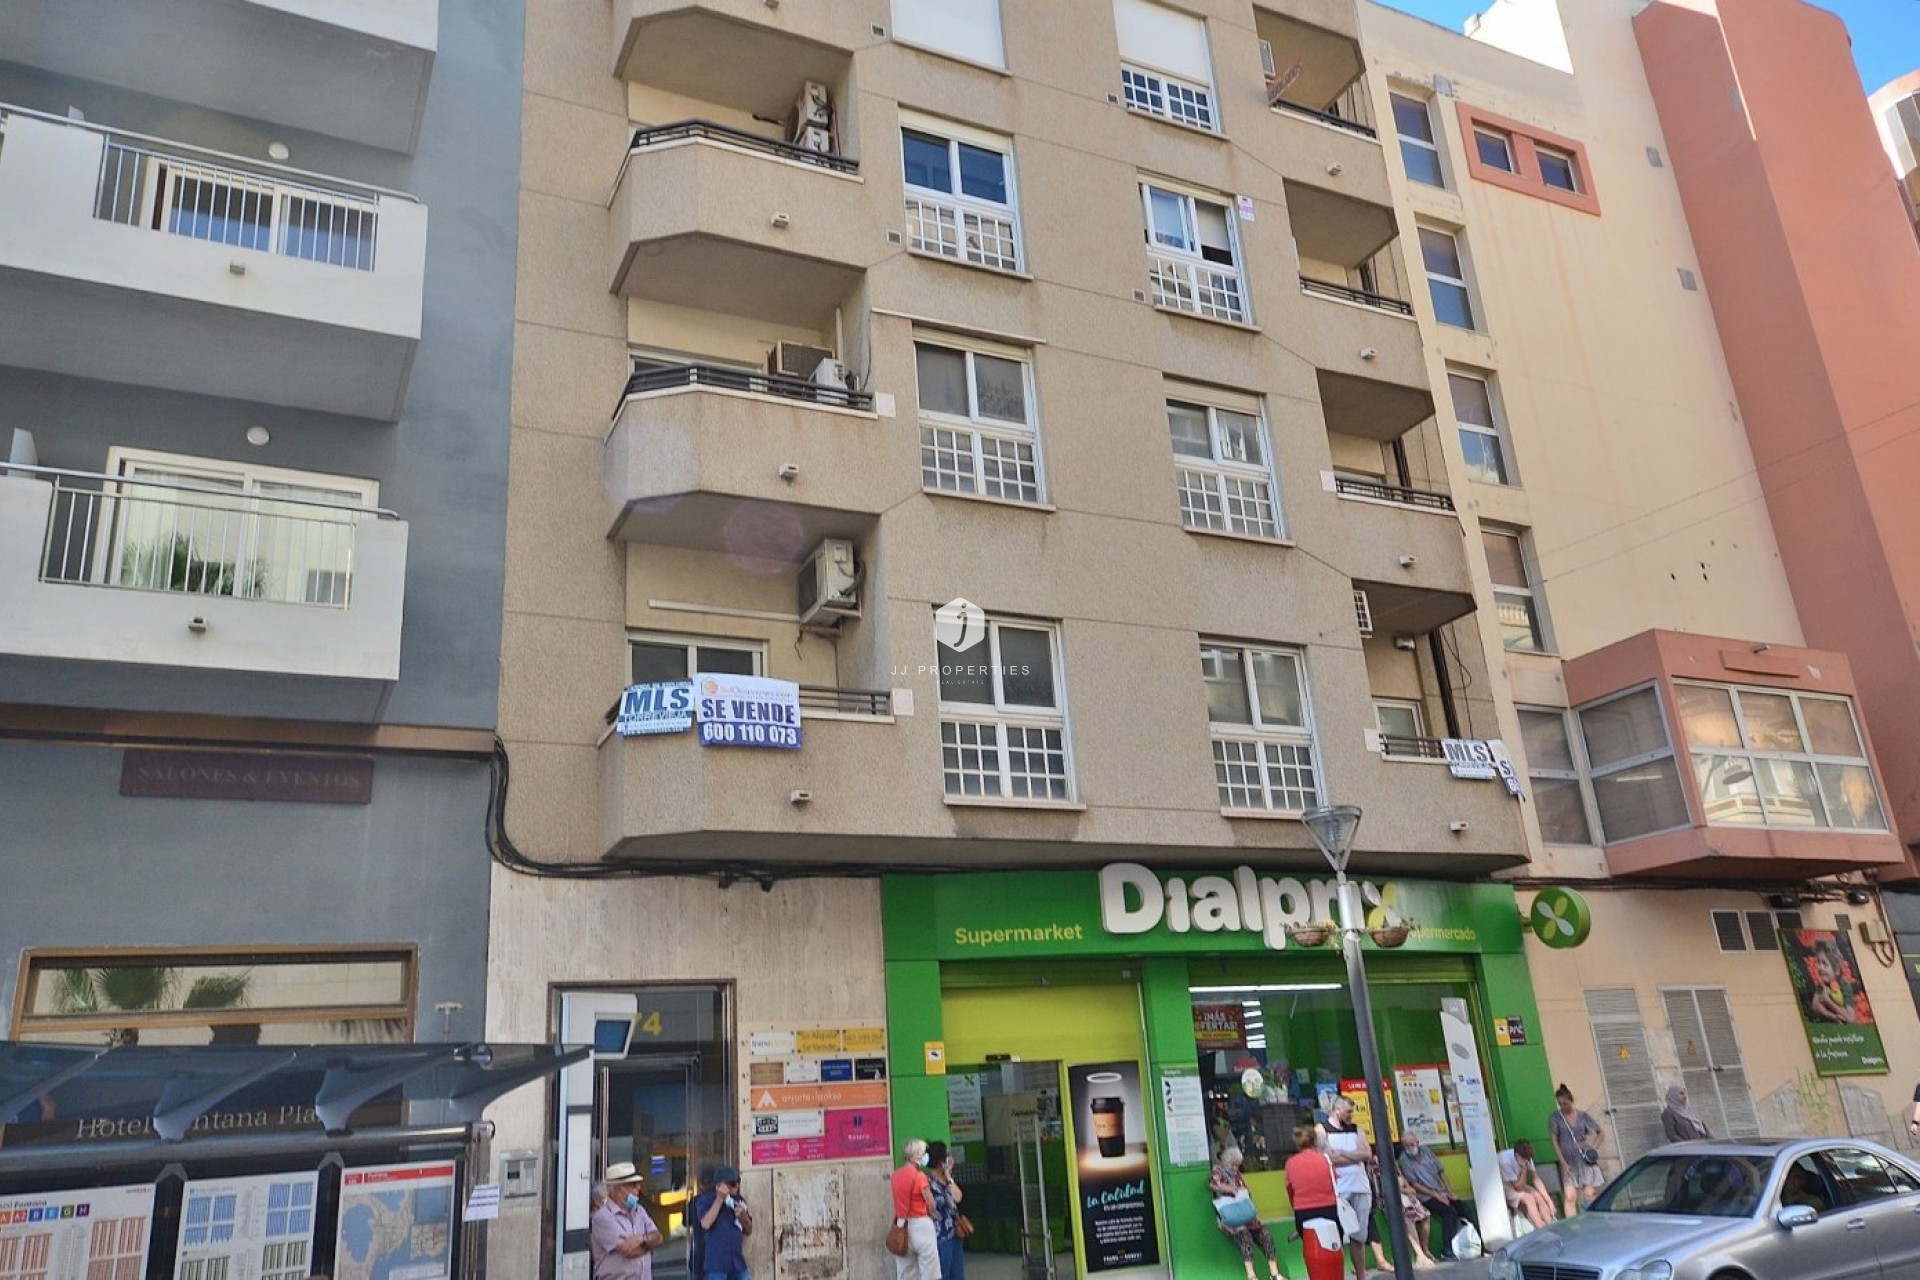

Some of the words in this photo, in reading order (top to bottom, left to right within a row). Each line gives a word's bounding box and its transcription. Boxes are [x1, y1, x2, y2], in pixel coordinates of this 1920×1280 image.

[624, 687, 690, 715] MLS
[702, 698, 727, 719] SE
[731, 700, 796, 724] VENDE
[703, 721, 735, 742] 600
[738, 724, 764, 742] 110
[769, 727, 797, 745] 073
[1445, 743, 1488, 762] MLS
[137, 766, 237, 784] SALONES
[266, 770, 360, 787] EVENTOS
[955, 923, 1083, 947] Supermarket
[1408, 926, 1477, 942] upermercado
[76, 1116, 151, 1139] Hotel
[191, 1108, 268, 1130] ntana
[278, 1105, 320, 1124] Pla
